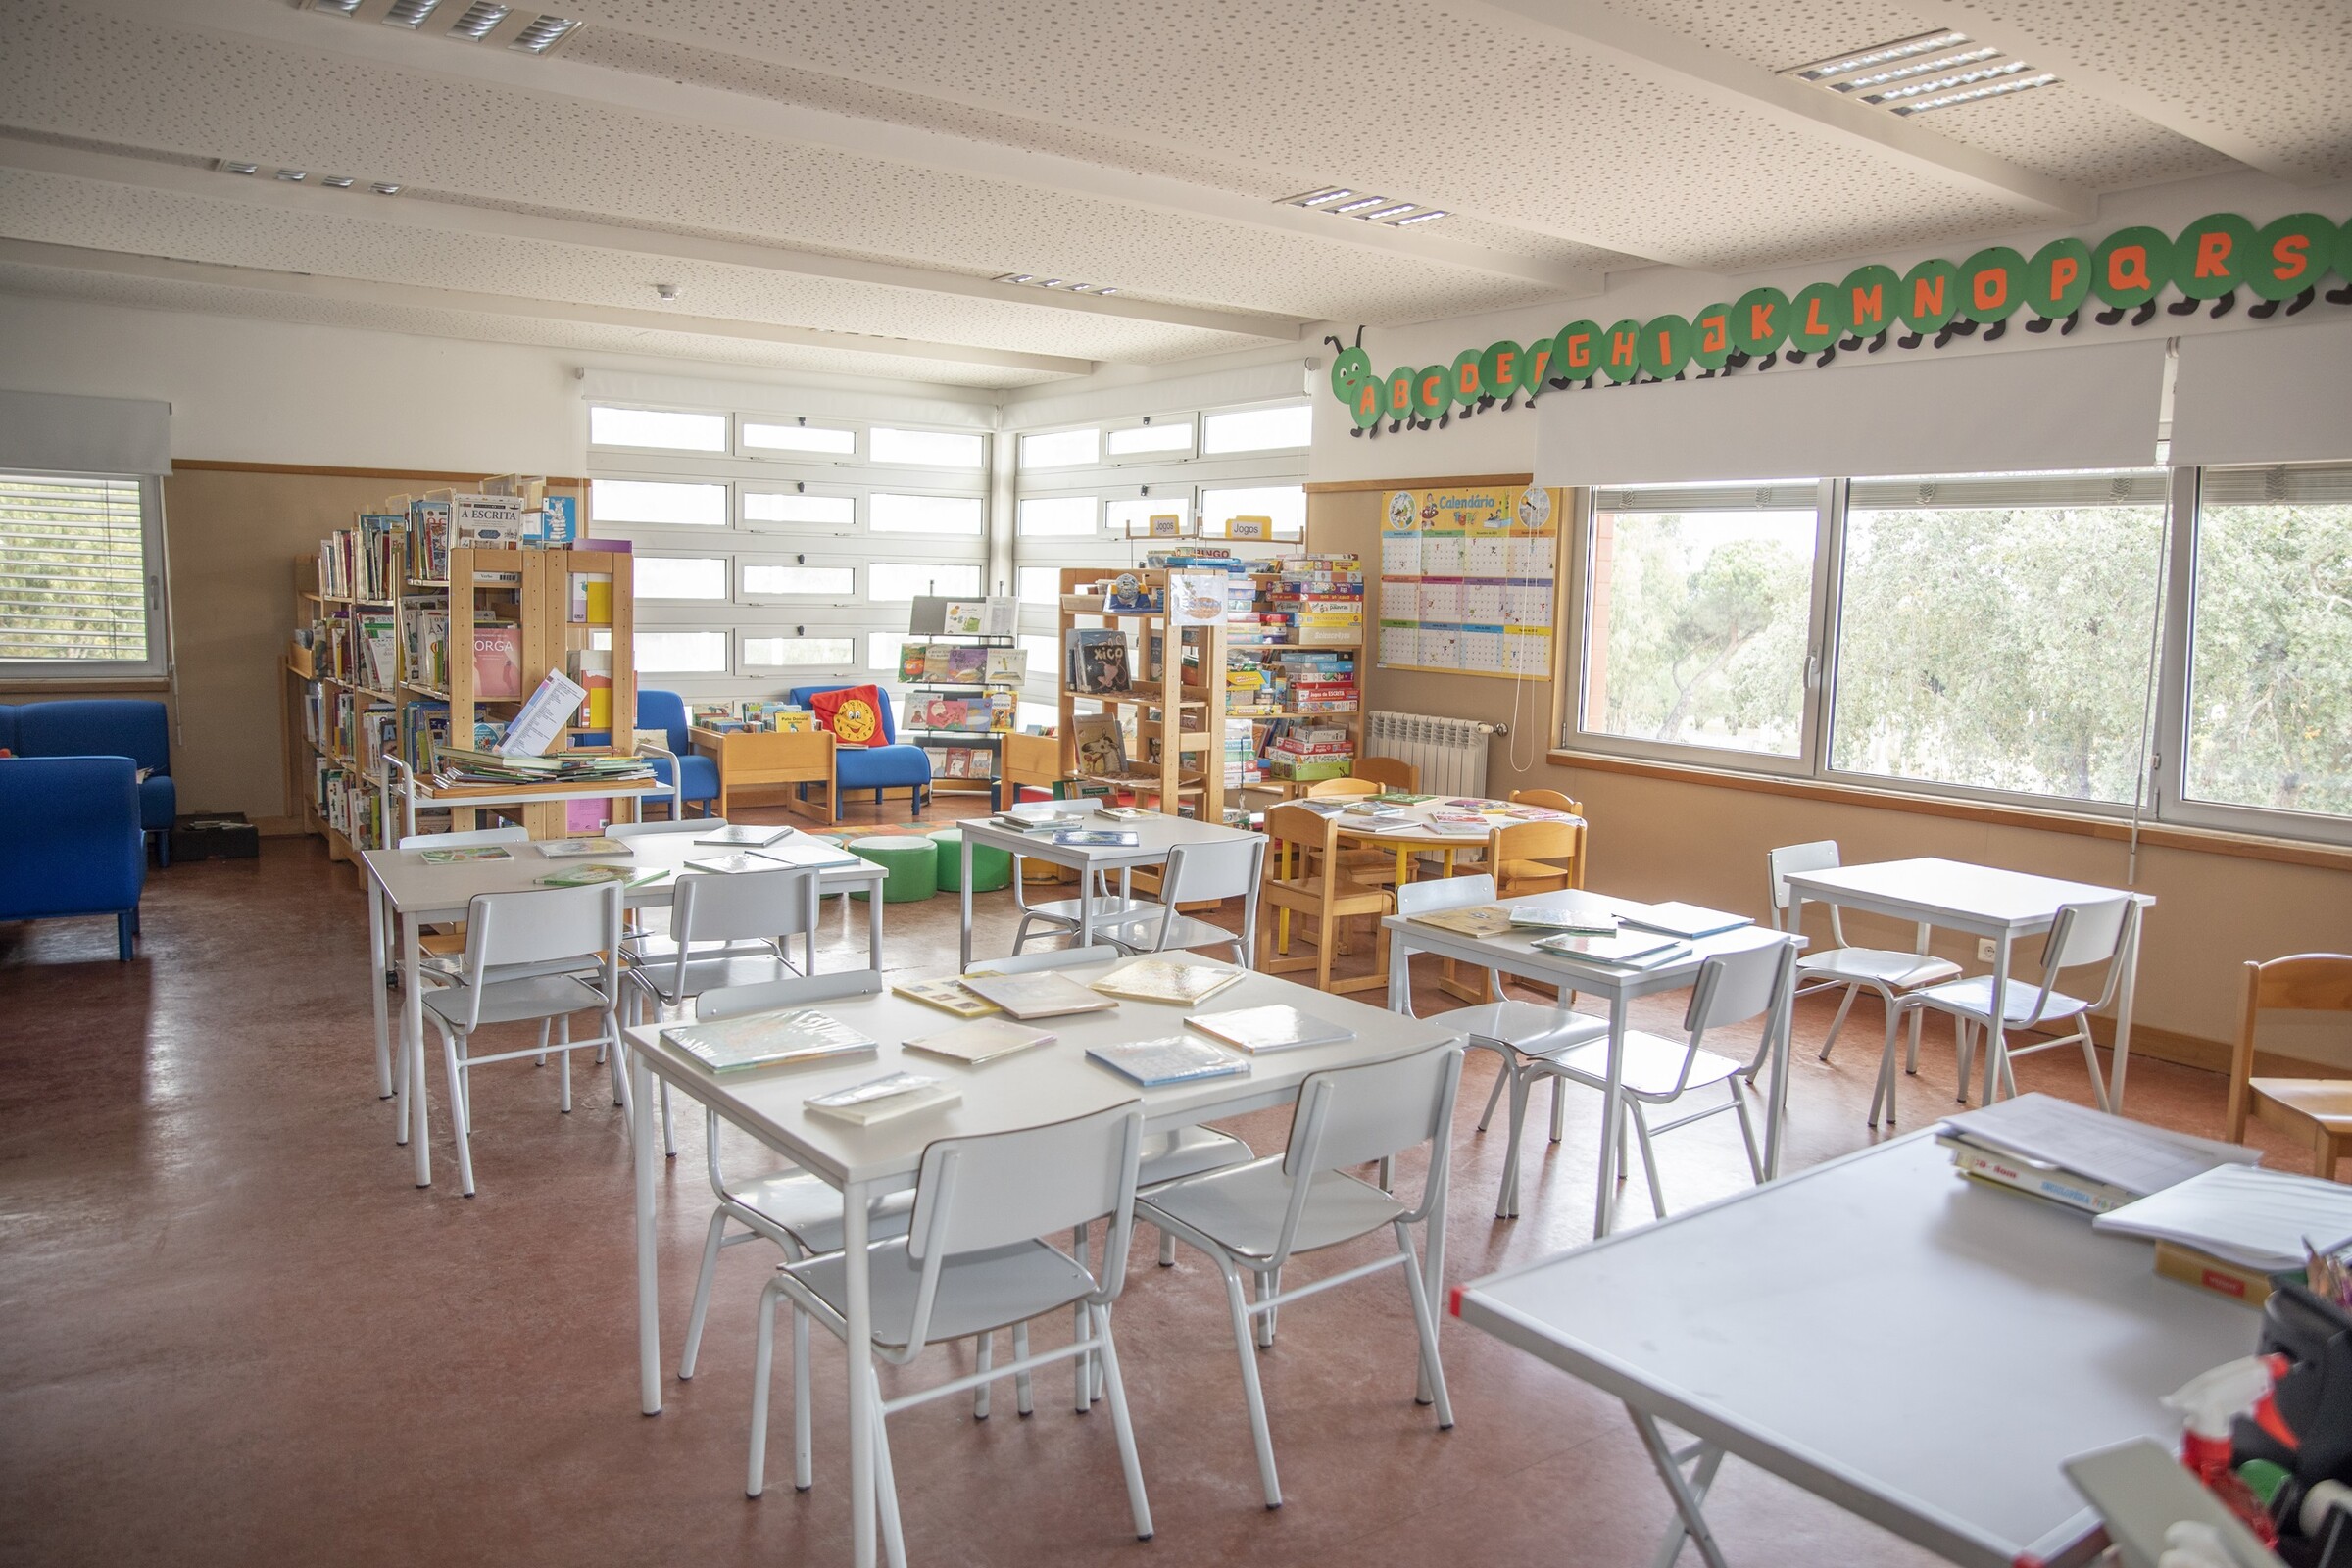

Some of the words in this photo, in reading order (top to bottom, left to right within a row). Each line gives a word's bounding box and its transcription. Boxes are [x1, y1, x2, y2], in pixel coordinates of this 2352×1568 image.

[1359, 385, 1376, 415] A
[1393, 379, 1409, 409] B
[1422, 376, 1441, 407] C
[1459, 363, 1479, 393] D
[1496, 353, 1514, 383] E
[1534, 352, 1550, 384] F
[1568, 333, 1590, 367] G
[1611, 332, 1635, 366] H
[1658, 331, 1672, 366] I
[1702, 315, 1726, 353] J
[1751, 303, 1775, 340] K
[1804, 298, 1829, 335] L
[1852, 284, 1883, 326] M
[1913, 275, 1944, 318] N
[1973, 268, 2007, 310] O
[2050, 257, 2078, 301] P
[2108, 245, 2151, 291] Q
[2194, 232, 2233, 279] R
[2272, 234, 2310, 281] S
[1439, 494, 1494, 510] Calendário
[472, 510, 516, 520] ESCRITA
[1156, 521, 1174, 532] Jogos
[1233, 524, 1259, 535] Jogos
[1193, 548, 1229, 558] BINGO
[474, 640, 514, 651] ORGA
